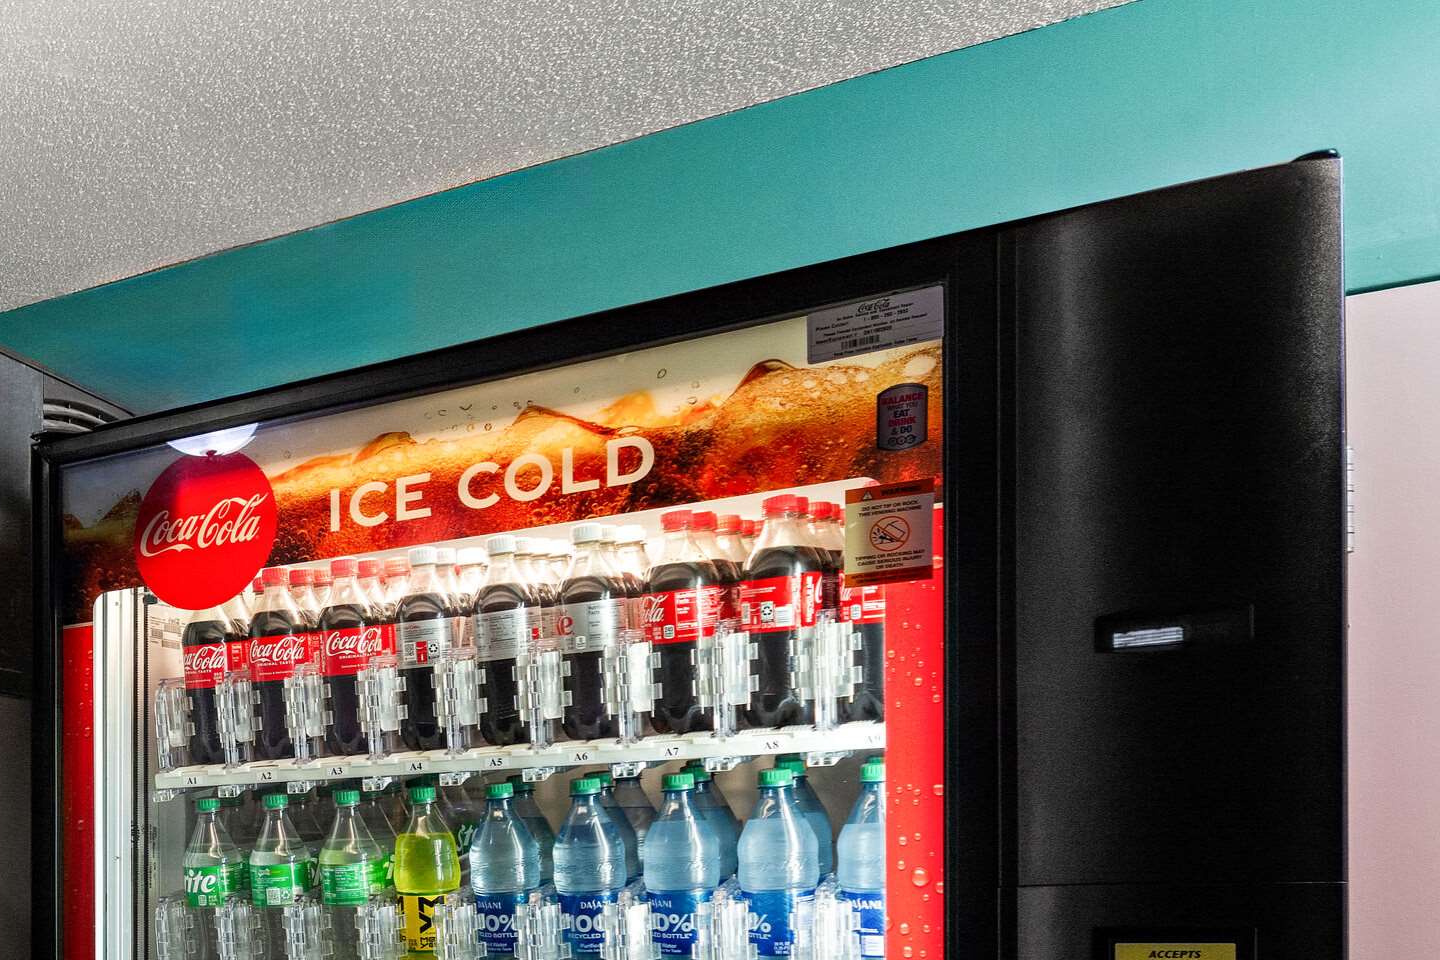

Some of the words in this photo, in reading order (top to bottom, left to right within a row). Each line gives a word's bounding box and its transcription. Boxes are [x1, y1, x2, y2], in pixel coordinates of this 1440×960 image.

[894, 409, 910, 418] EAT
[900, 425, 912, 433] DO
[329, 473, 432, 532] ICE
[457, 435, 655, 510] COLD
[140, 491, 269, 557] Coca-Cola
[250, 636, 306, 663] Coca-Cola
[764, 740, 780, 750] A8
[574, 752, 588, 761] A6
[664, 747, 679, 757] A7
[489, 757, 503, 767] A5
[331, 767, 343, 776] A3
[410, 763, 423, 771] A4
[260, 771, 272, 781] A2
[187, 777, 197, 785] A1
[580, 899, 606, 910] DASA
[651, 900, 672, 909] ASANI
[1148, 950, 1201, 959] ACCEPTS
